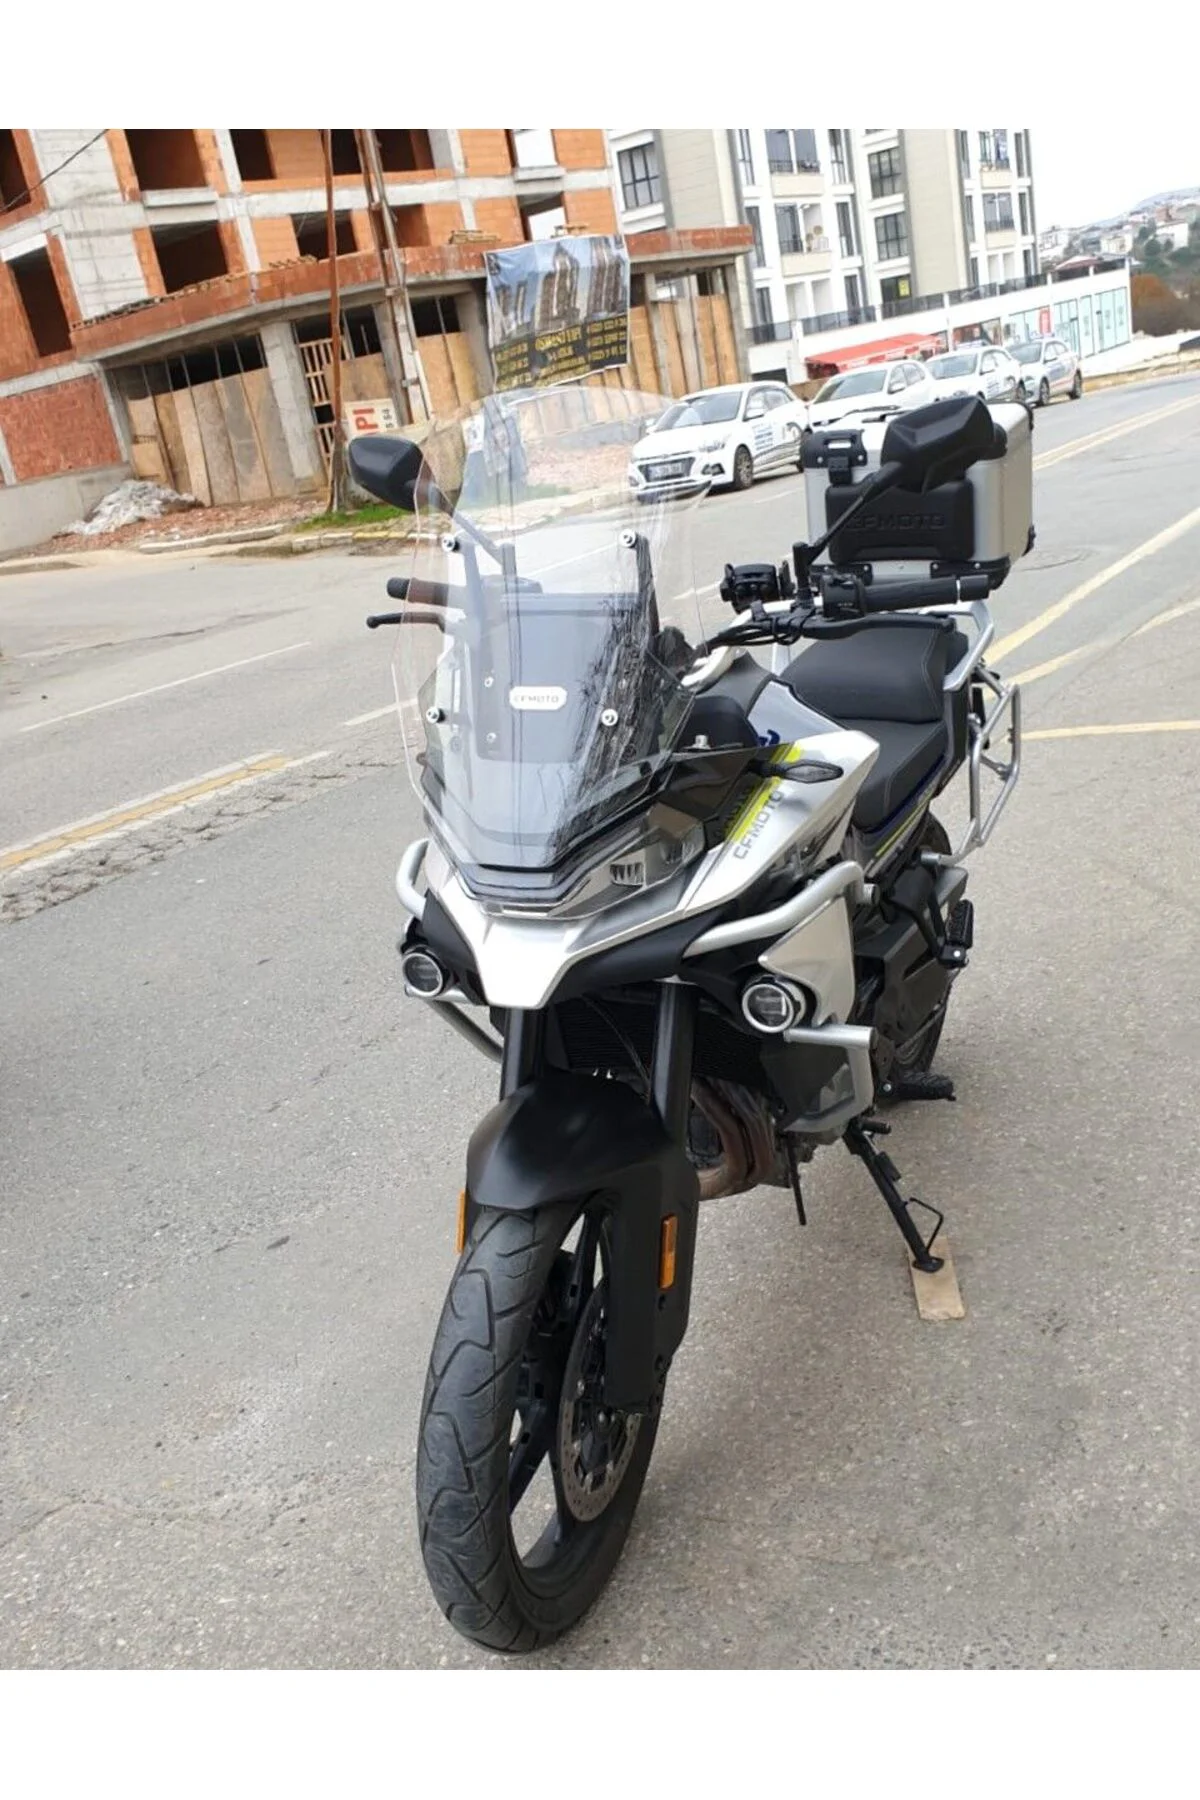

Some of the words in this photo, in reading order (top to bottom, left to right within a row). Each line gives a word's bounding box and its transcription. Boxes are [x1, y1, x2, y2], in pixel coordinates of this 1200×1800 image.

[352, 408, 379, 436] PI
[850, 513, 946, 530] CFMOTO
[513, 694, 560, 704] CFMOTO
[732, 790, 785, 860] CFMOTO
